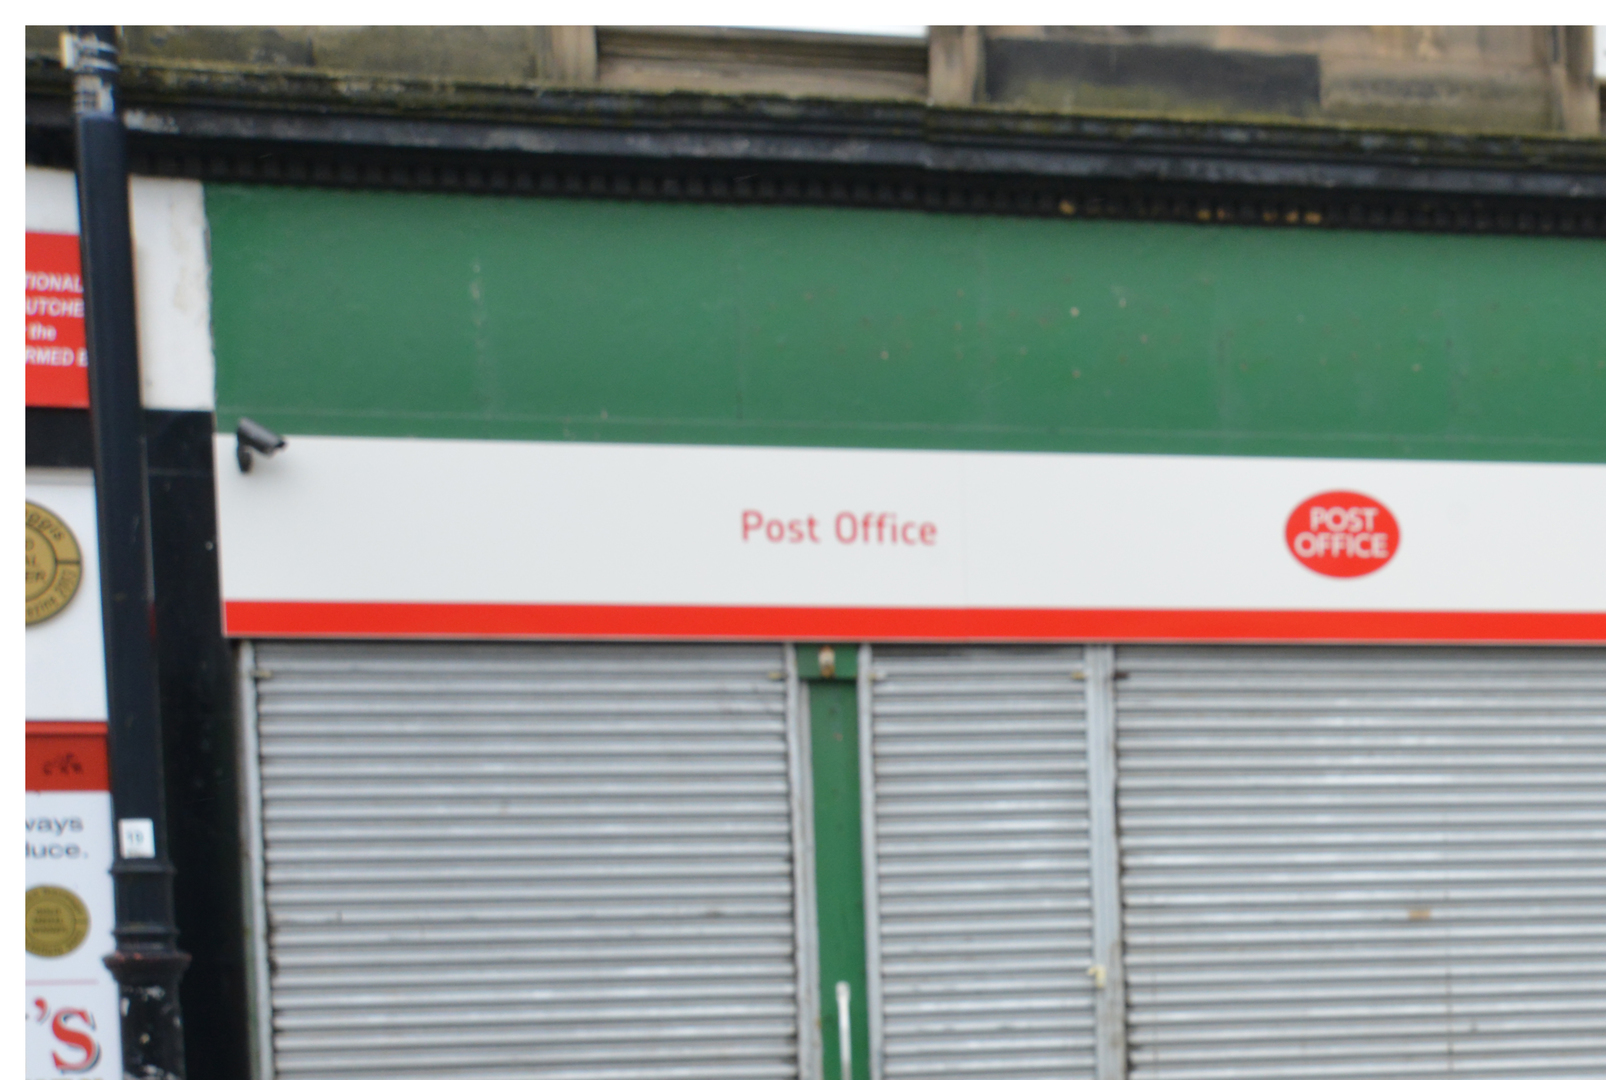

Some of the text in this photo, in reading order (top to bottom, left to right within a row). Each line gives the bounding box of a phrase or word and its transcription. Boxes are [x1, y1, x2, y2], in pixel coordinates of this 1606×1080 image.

[29, 321, 57, 342] the
[742, 509, 937, 546] Post Office
[1310, 506, 1379, 532] POST
[1294, 531, 1389, 559] OFFICE
